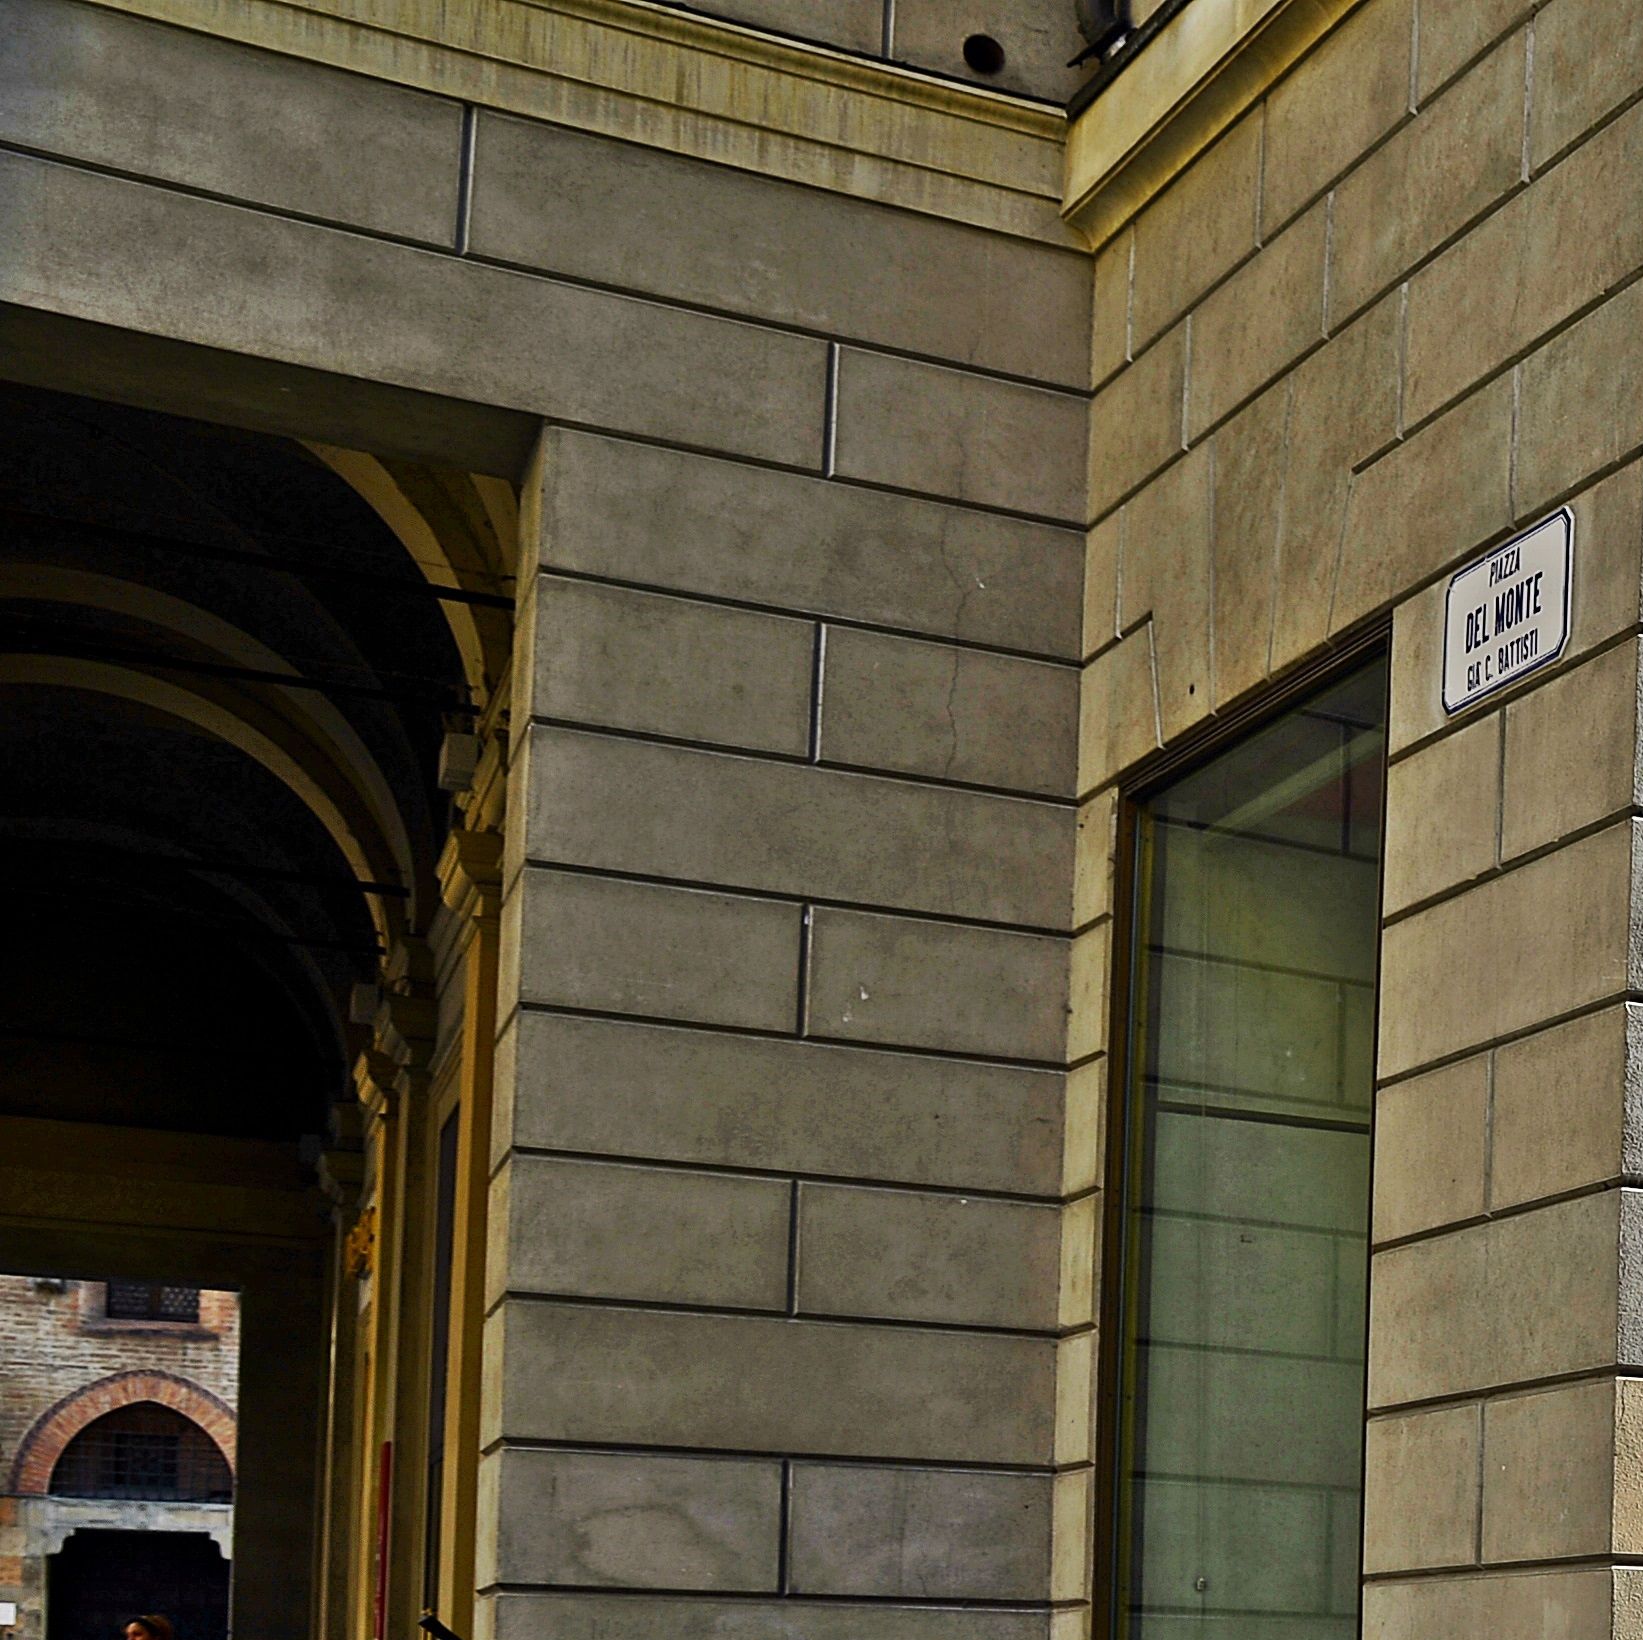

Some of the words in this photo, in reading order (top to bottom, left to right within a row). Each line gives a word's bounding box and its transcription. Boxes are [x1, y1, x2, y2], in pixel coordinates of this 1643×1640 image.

[1489, 547, 1521, 587] PIAZZA
[1465, 604, 1490, 654] DEL
[1494, 571, 1543, 636] MONTE
[1485, 655, 1494, 681] C.
[1498, 628, 1538, 675] BATTISTI
